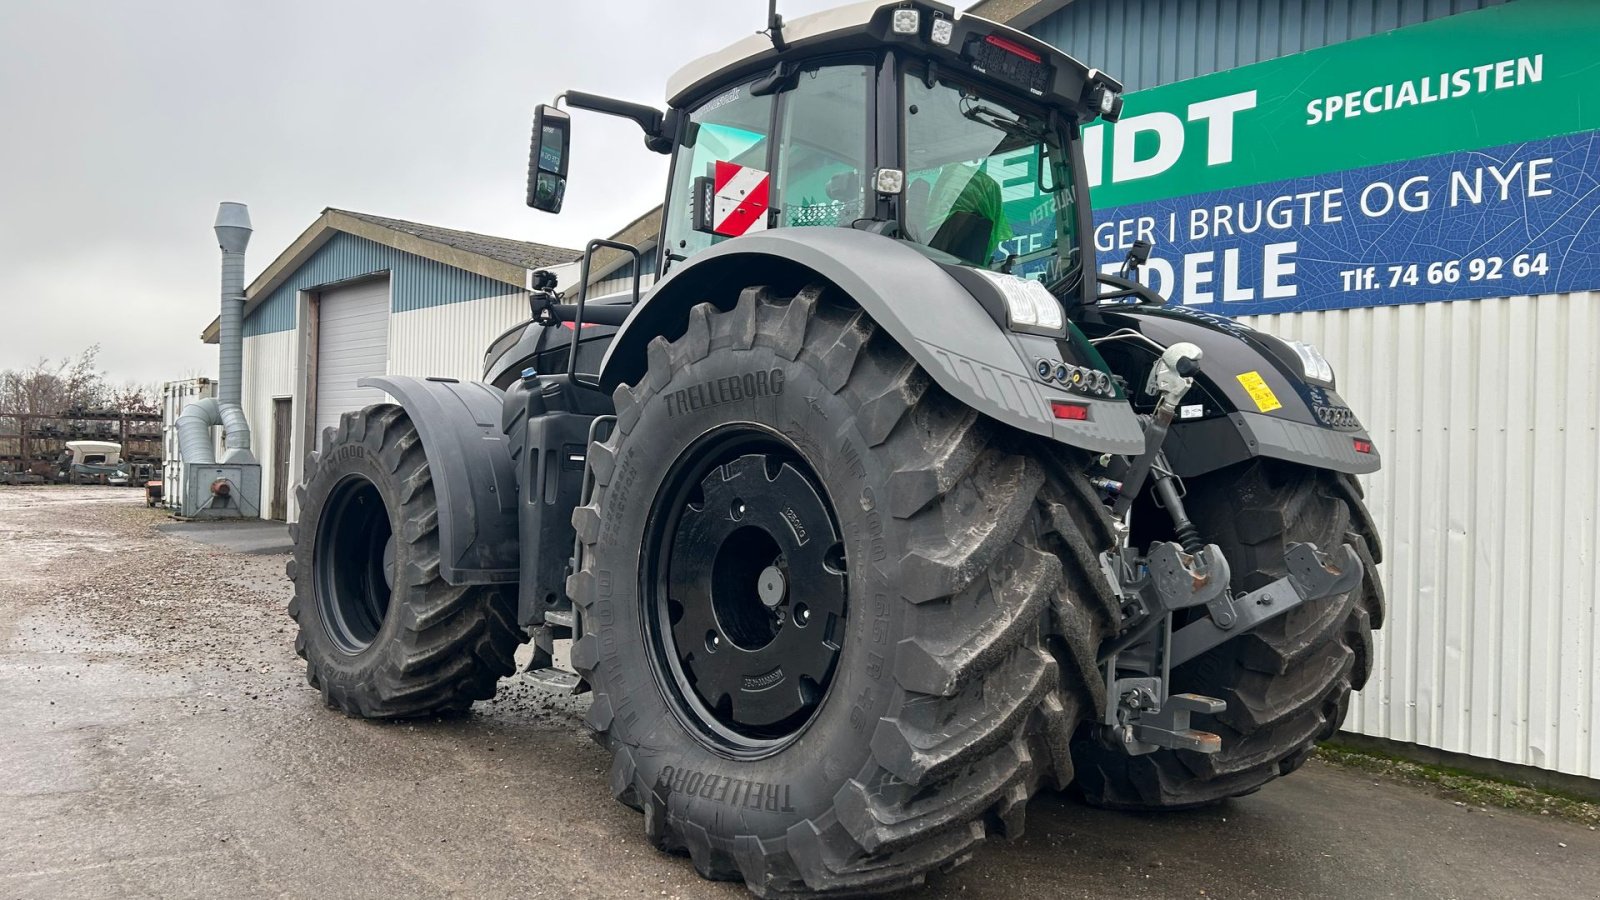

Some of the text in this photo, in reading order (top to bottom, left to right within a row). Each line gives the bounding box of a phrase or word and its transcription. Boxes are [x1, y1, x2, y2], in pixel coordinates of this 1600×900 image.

[1305, 54, 1543, 125] SPECIALISTEN
[1093, 216, 1156, 252] GER
[1169, 212, 1176, 243] I
[1190, 187, 1343, 241] BRUGTE
[1360, 175, 1429, 217] OG
[1450, 158, 1553, 207] NYE
[1340, 252, 1548, 292] Tlf. 74 66 92 64
[663, 367, 785, 419] TRELLEBORG
[660, 764, 798, 814] TRELLEBORG
